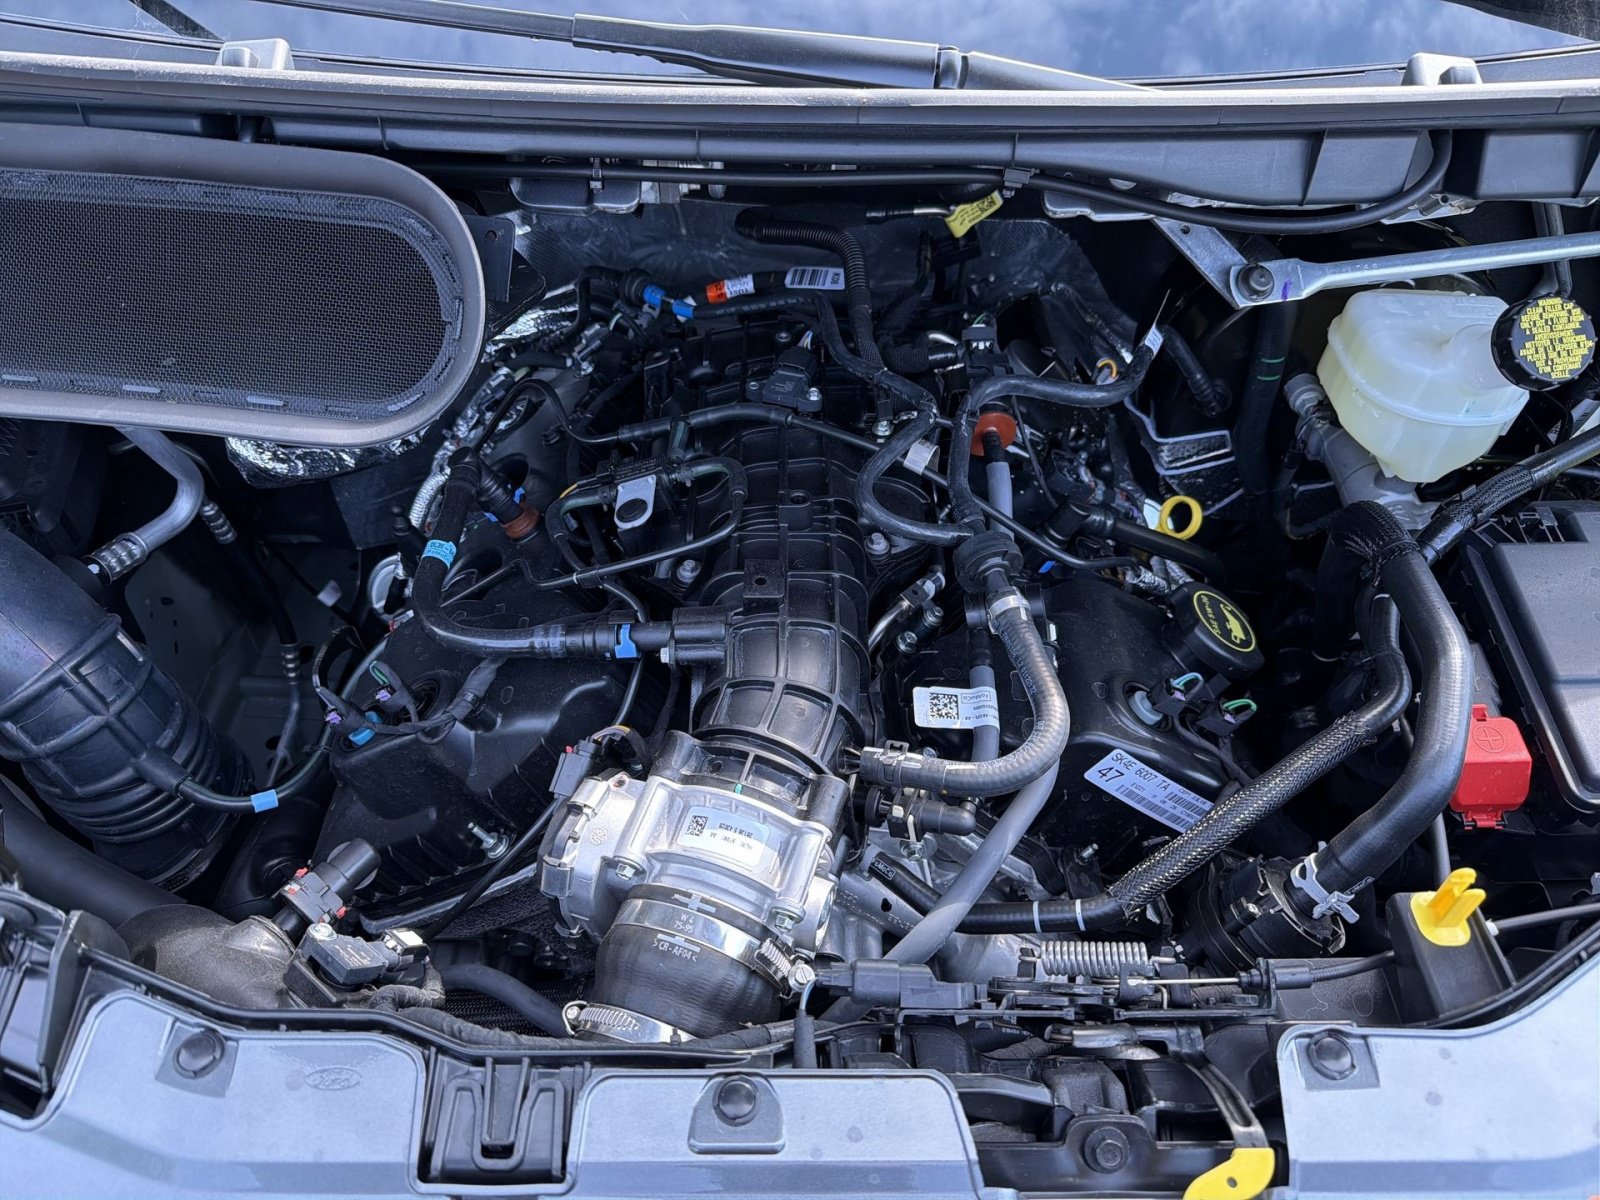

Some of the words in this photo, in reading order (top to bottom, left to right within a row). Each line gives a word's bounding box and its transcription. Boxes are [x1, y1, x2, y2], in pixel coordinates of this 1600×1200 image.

[1521, 321, 1534, 329] ONLY
[1570, 314, 1584, 322] FROM
[1532, 325, 1550, 333] SEALED
[1525, 340, 1550, 348] NETTOYER
[1563, 335, 1586, 343] BOUCHON
[1520, 348, 1535, 356] AVANT
[1570, 348, 1589, 356] LIQUIDE
[1554, 355, 1582, 365] PROVENANT
[1553, 362, 1581, 371] CONTENANT
[963, 693, 989, 701] FoMoCo
[1097, 767, 1125, 782] 47
[1112, 753, 1136, 770] SK4E
[1134, 768, 1158, 782] 6007
[1156, 780, 1171, 791] TA
[872, 859, 892, 877] FoMoCo
[674, 921, 694, 933] 75-95
